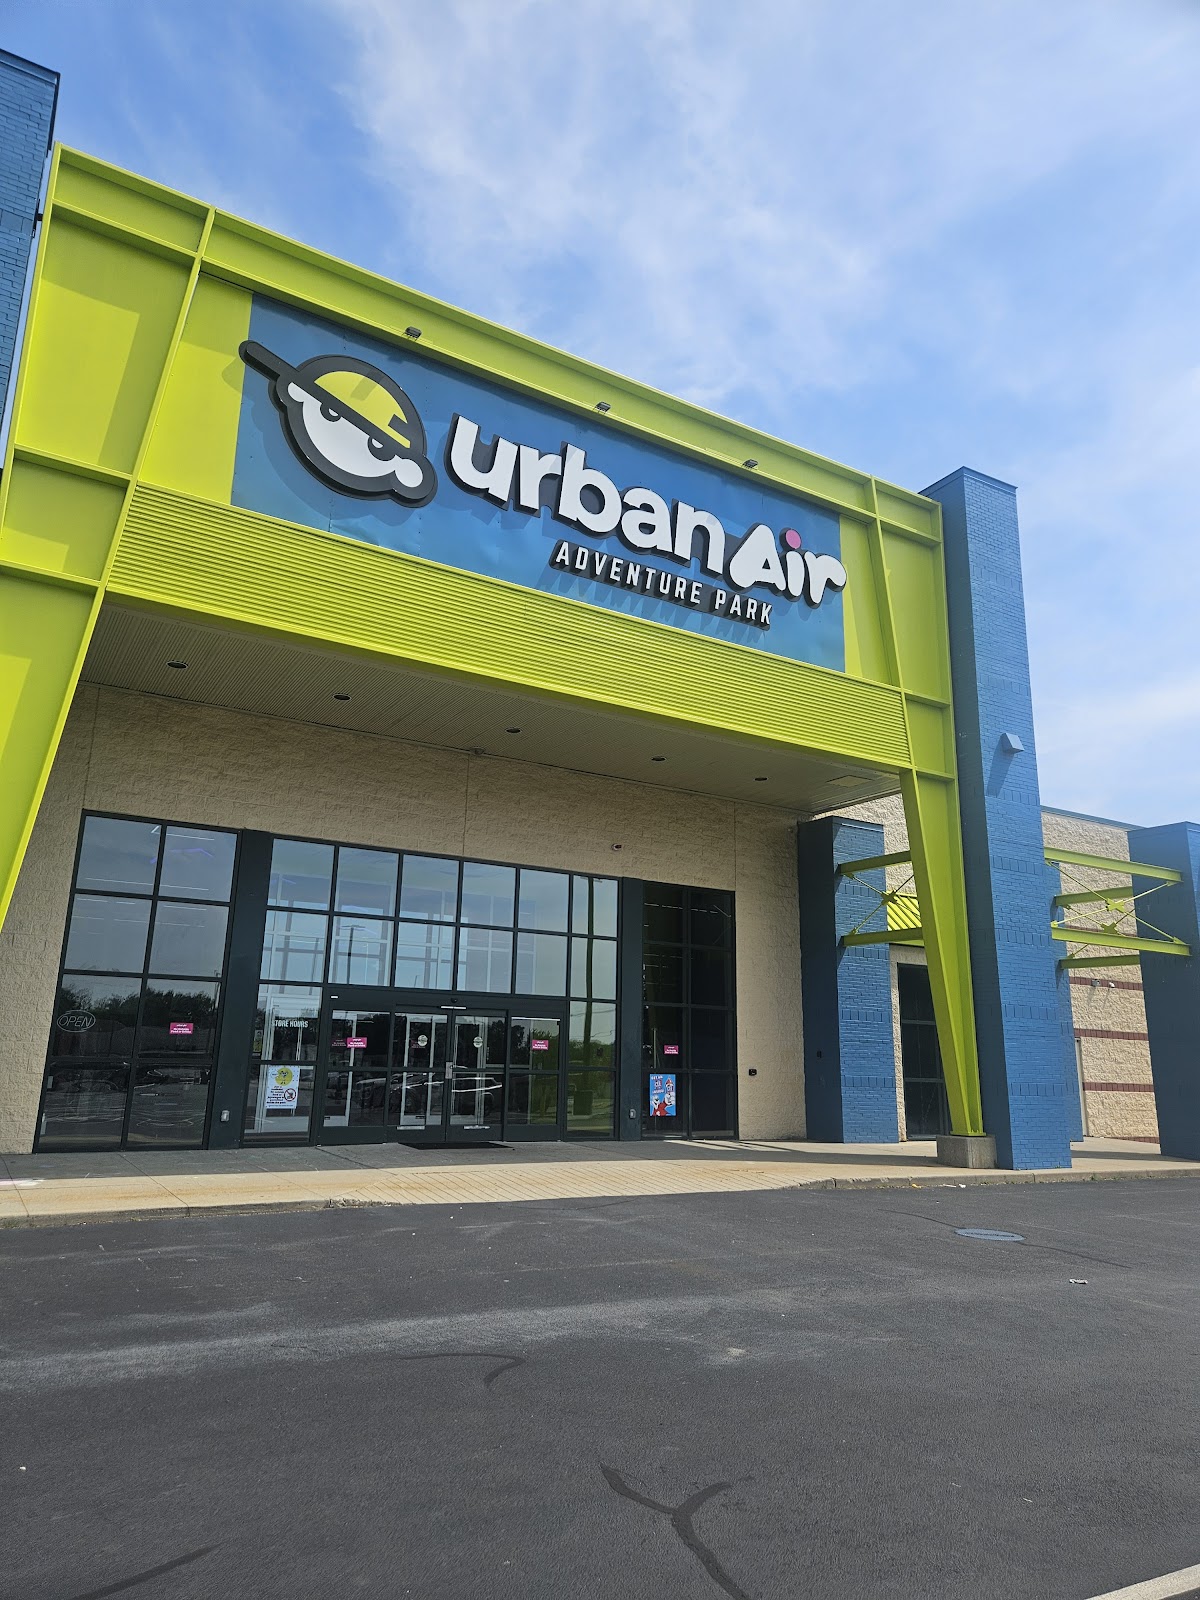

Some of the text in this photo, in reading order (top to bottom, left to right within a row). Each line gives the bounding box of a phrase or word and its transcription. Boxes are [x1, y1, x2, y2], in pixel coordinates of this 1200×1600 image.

[555, 541, 773, 626] ADVENTURE PARK
[59, 1015, 93, 1027] OPEN
[289, 1020, 309, 1028] HOURS
